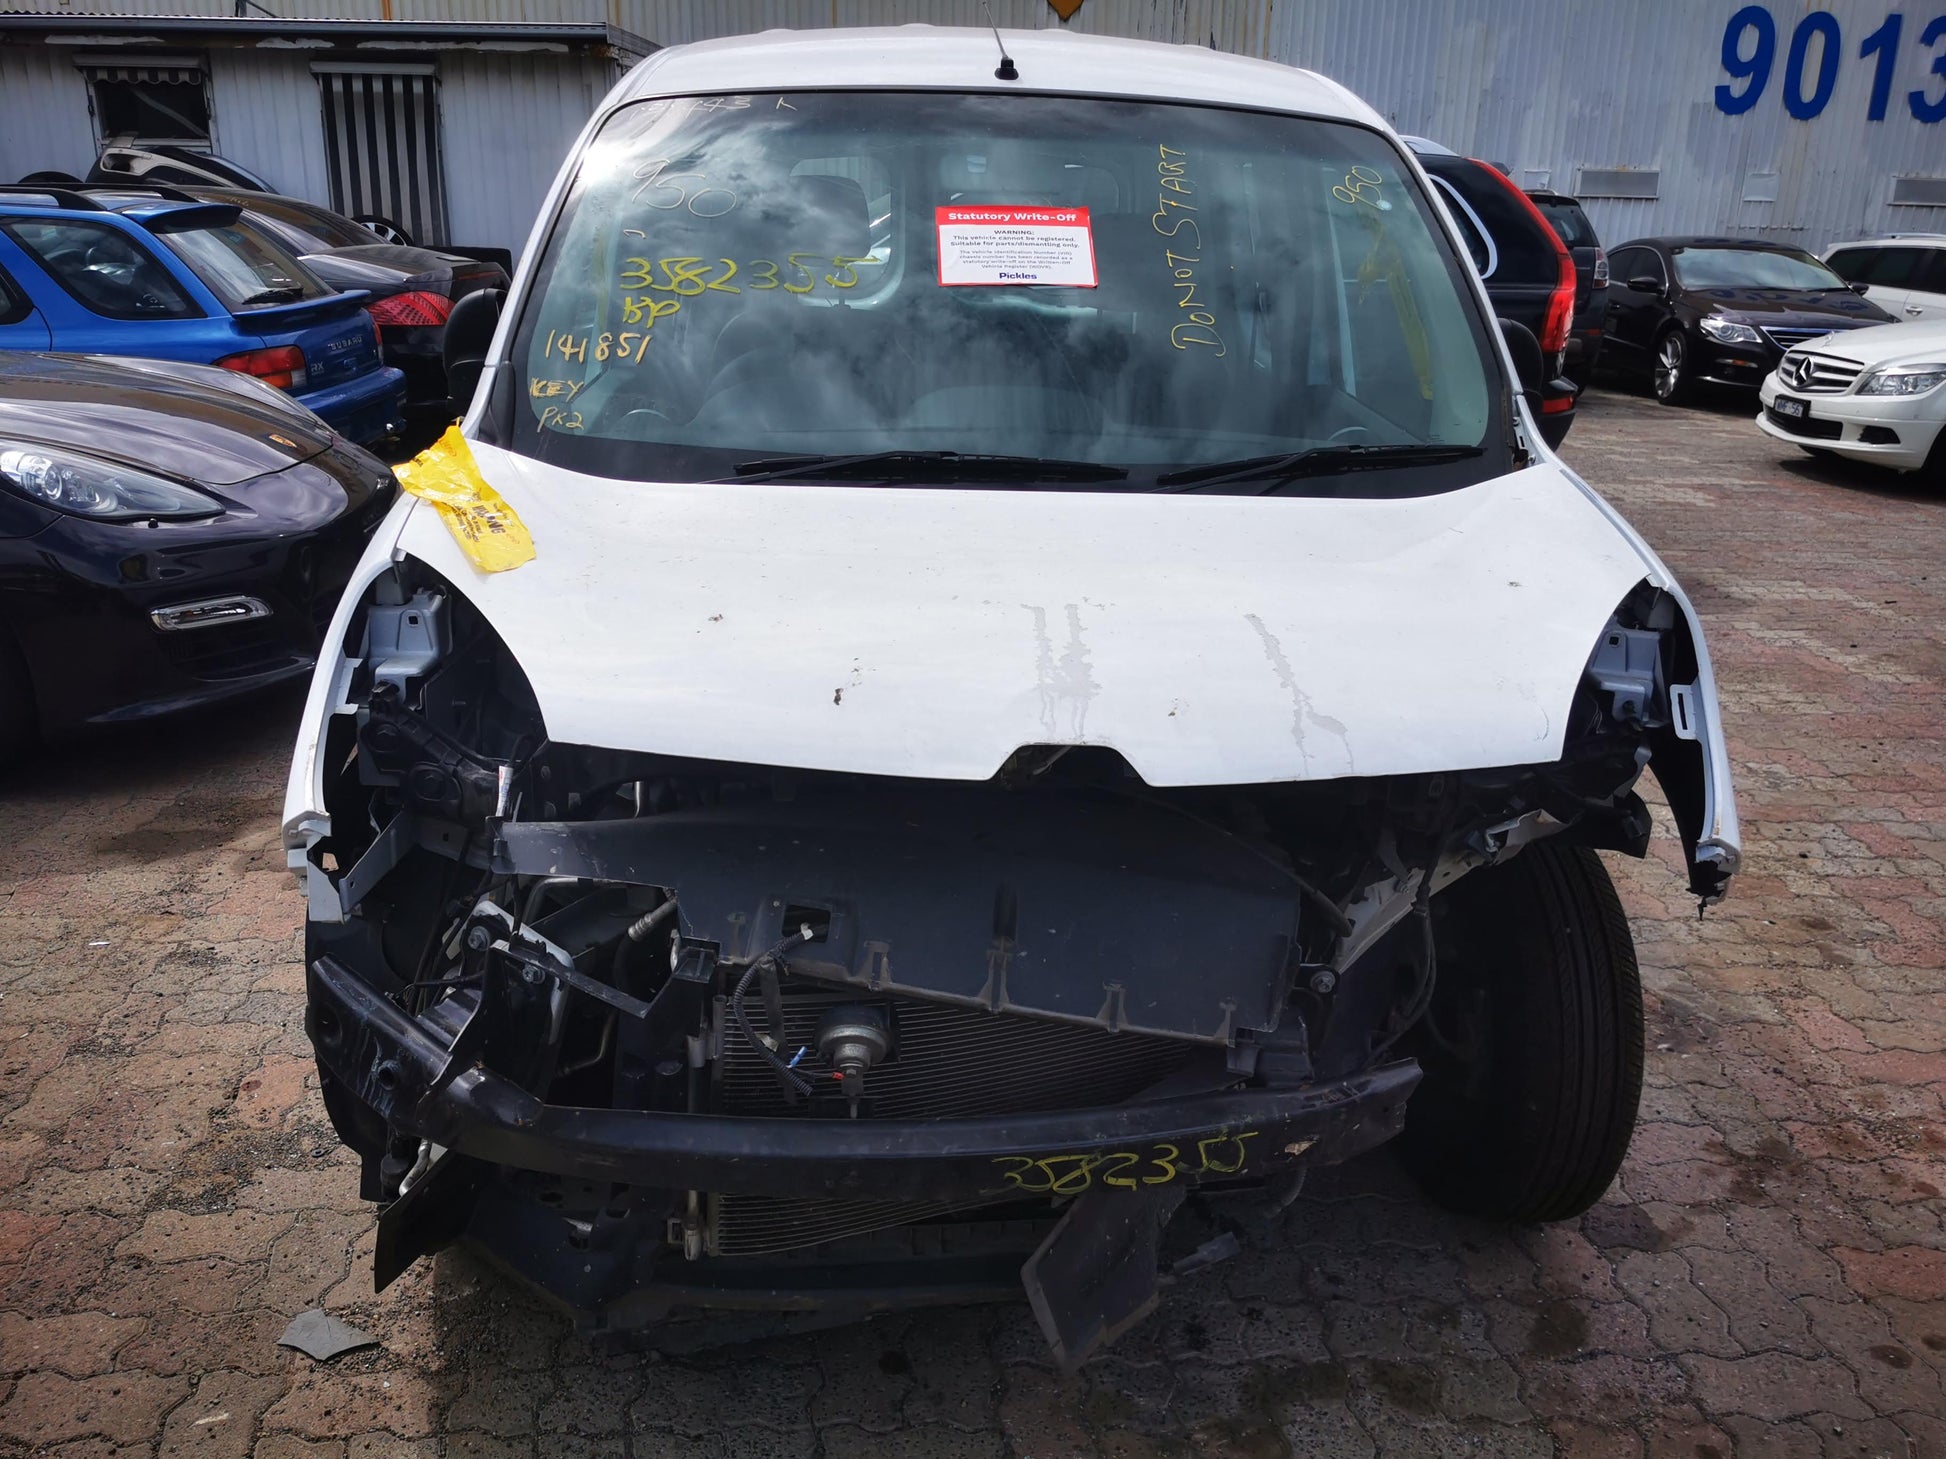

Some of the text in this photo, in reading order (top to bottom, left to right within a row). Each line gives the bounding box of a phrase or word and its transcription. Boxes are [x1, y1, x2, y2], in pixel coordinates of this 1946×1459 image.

[632, 159, 738, 218] 950
[1332, 165, 1386, 211] 950
[948, 212, 1077, 222] Statutory Write-Off
[999, 272, 1038, 280] Pickles
[328, 335, 363, 351] SUBARU
[529, 377, 585, 403] KEY
